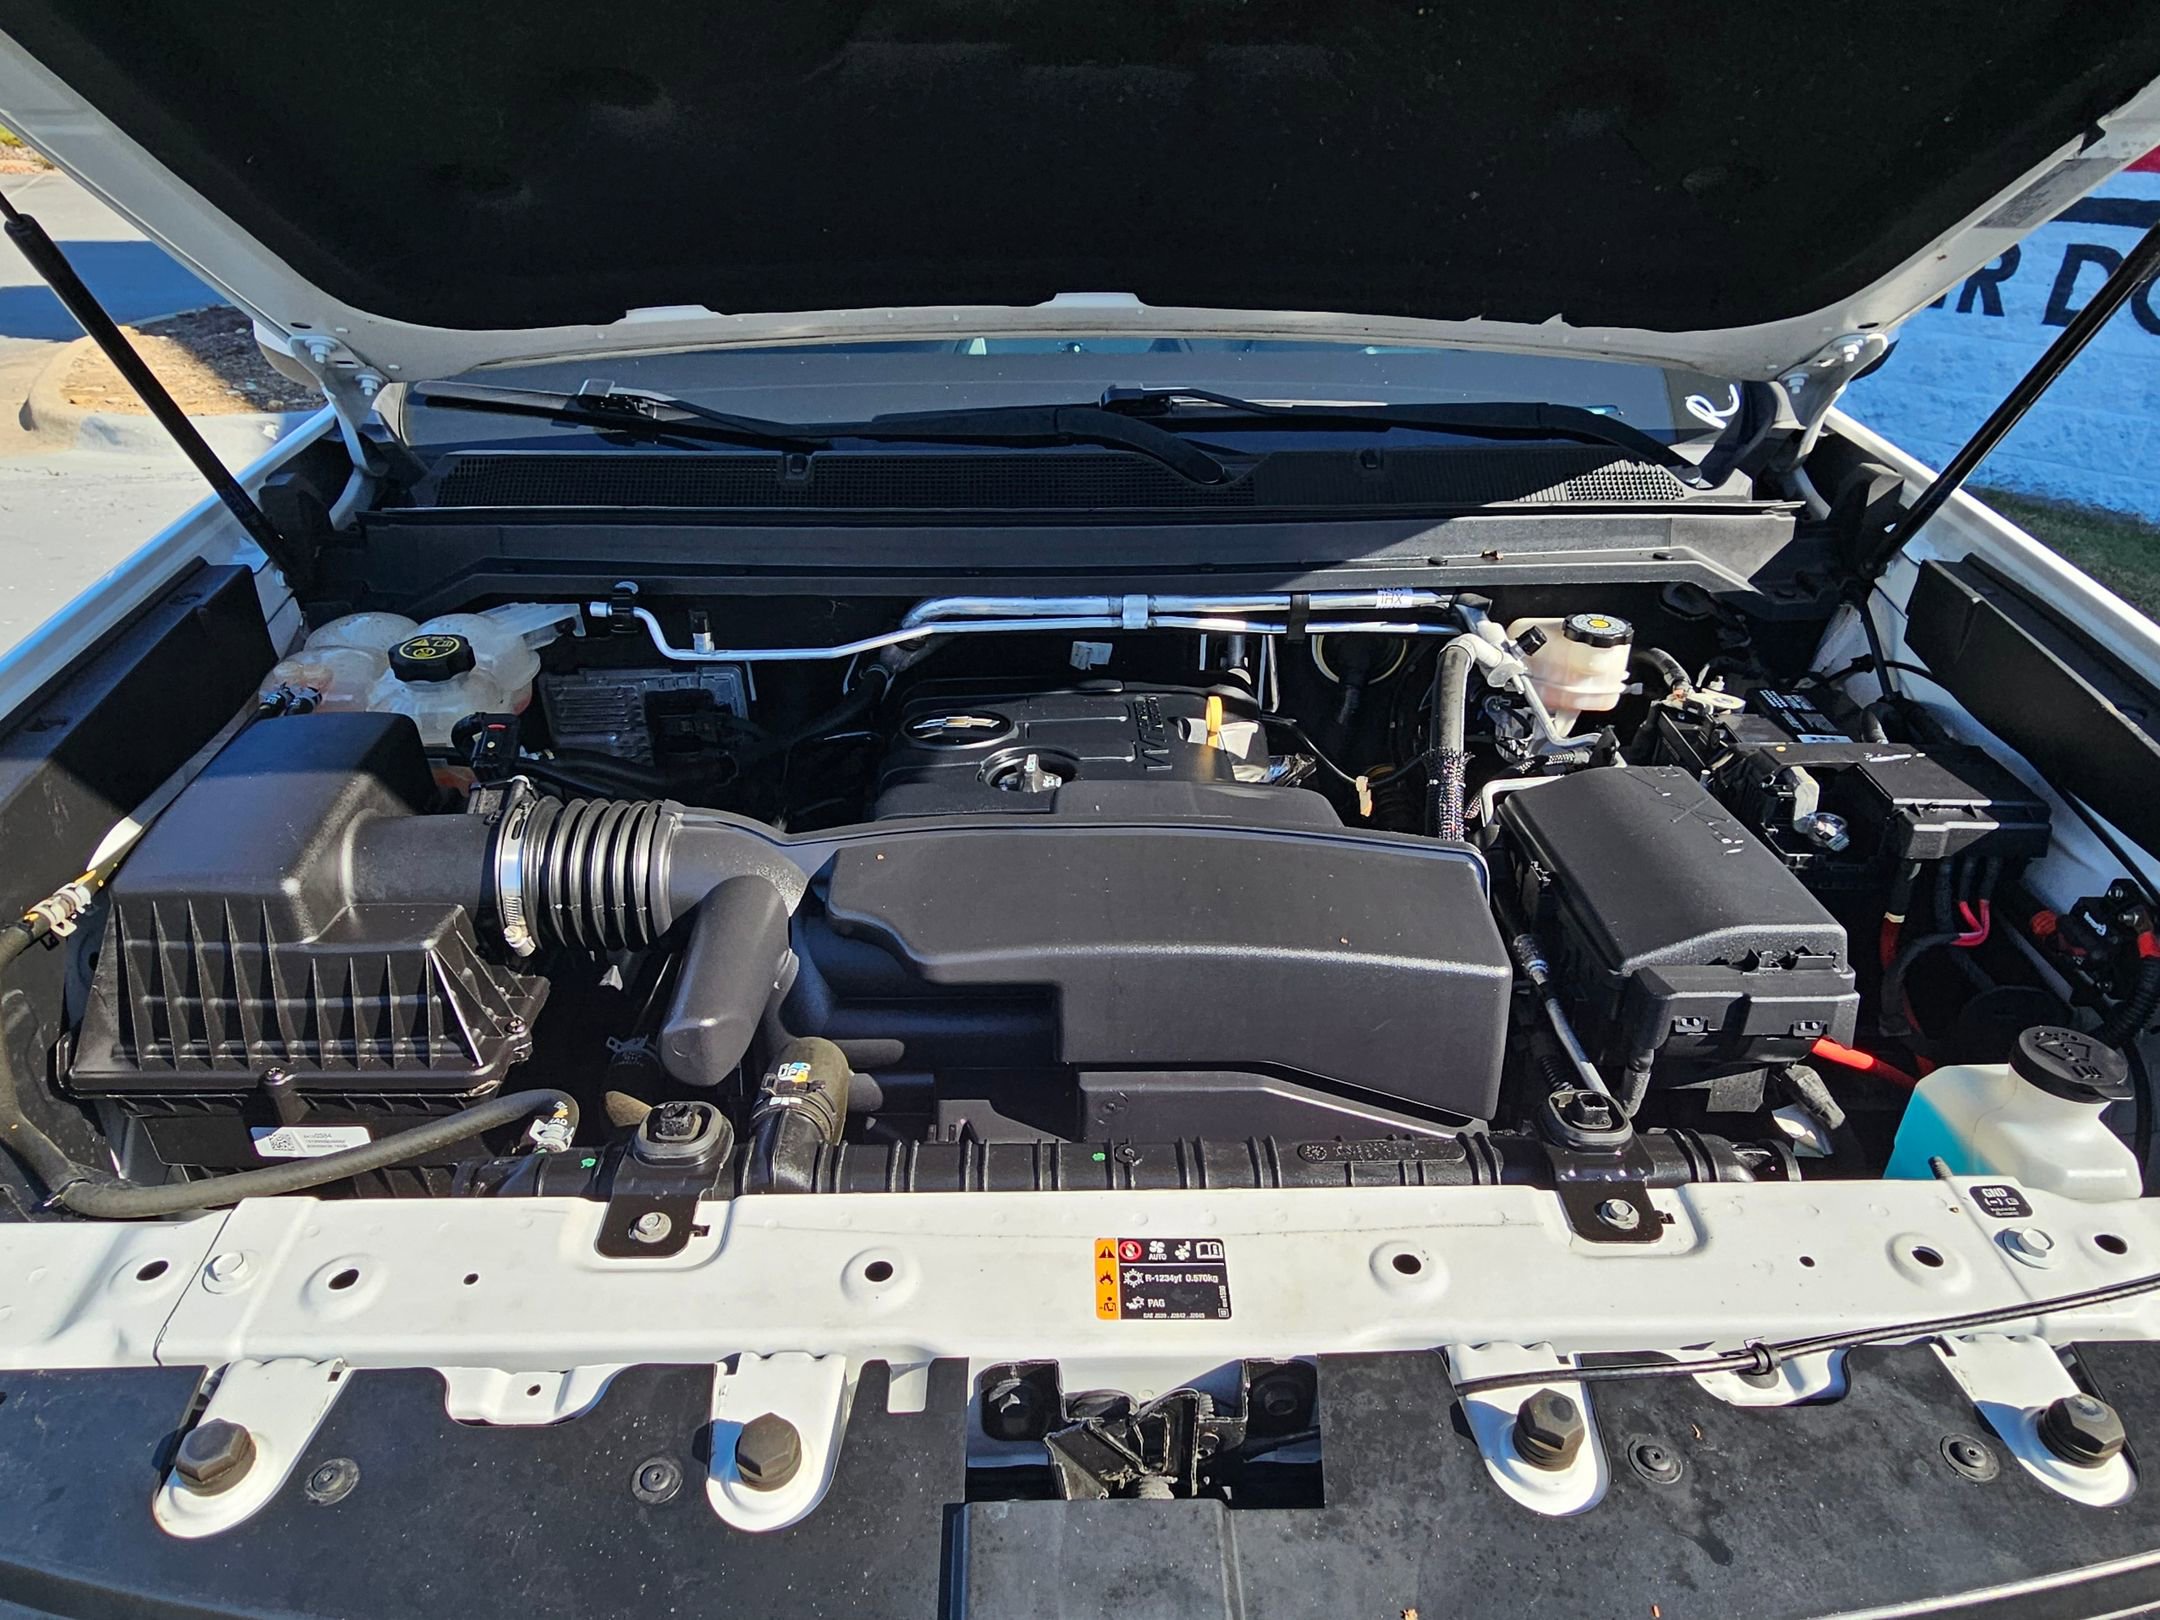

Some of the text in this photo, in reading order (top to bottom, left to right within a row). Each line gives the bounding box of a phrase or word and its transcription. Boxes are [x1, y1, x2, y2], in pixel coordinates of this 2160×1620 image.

[1928, 243, 2022, 317] R
[1981, 1187, 2007, 1198] GND
[1148, 1253, 1167, 1261] AUTO
[1144, 1273, 1182, 1284] R-1234yf
[1147, 1298, 1165, 1308] PAG
